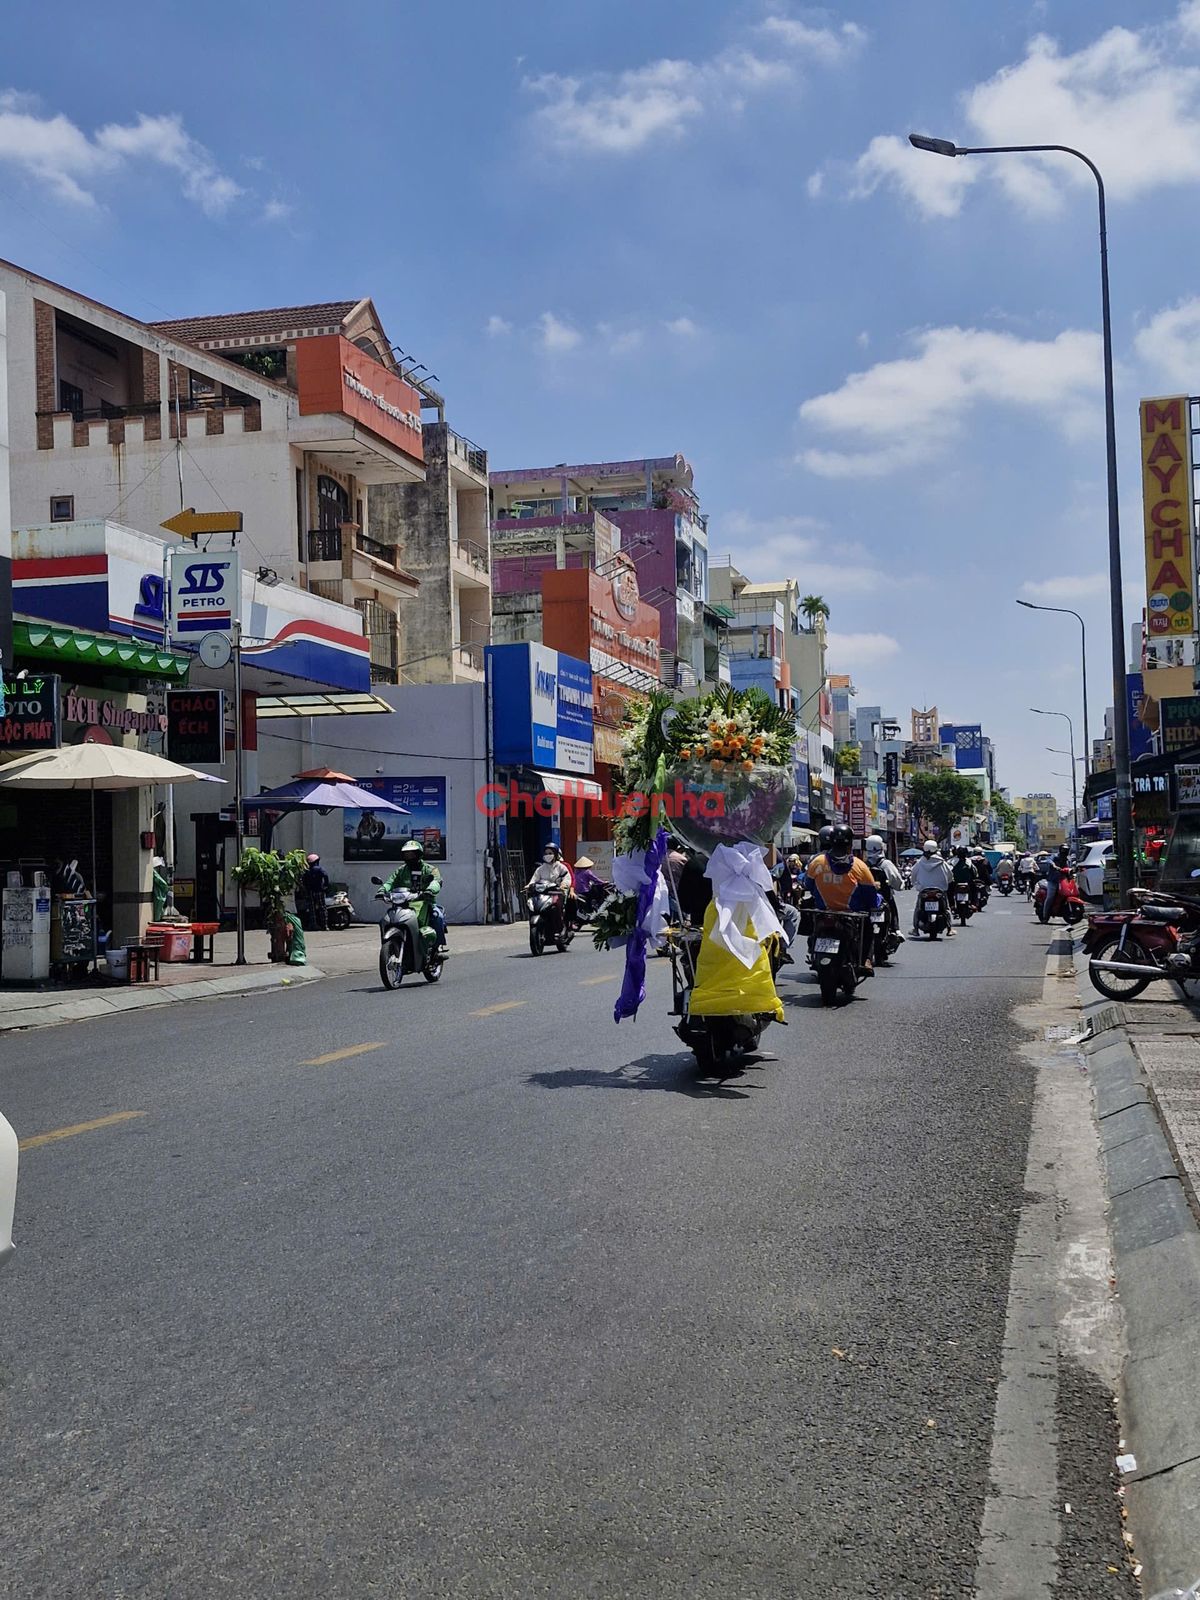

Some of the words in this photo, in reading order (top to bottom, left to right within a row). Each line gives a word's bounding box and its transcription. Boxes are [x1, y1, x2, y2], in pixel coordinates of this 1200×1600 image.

[178, 562, 231, 594] STS
[183, 597, 226, 607] PETRO
[102, 700, 169, 734] Singapore
[1134, 774, 1151, 792] TRÀ
